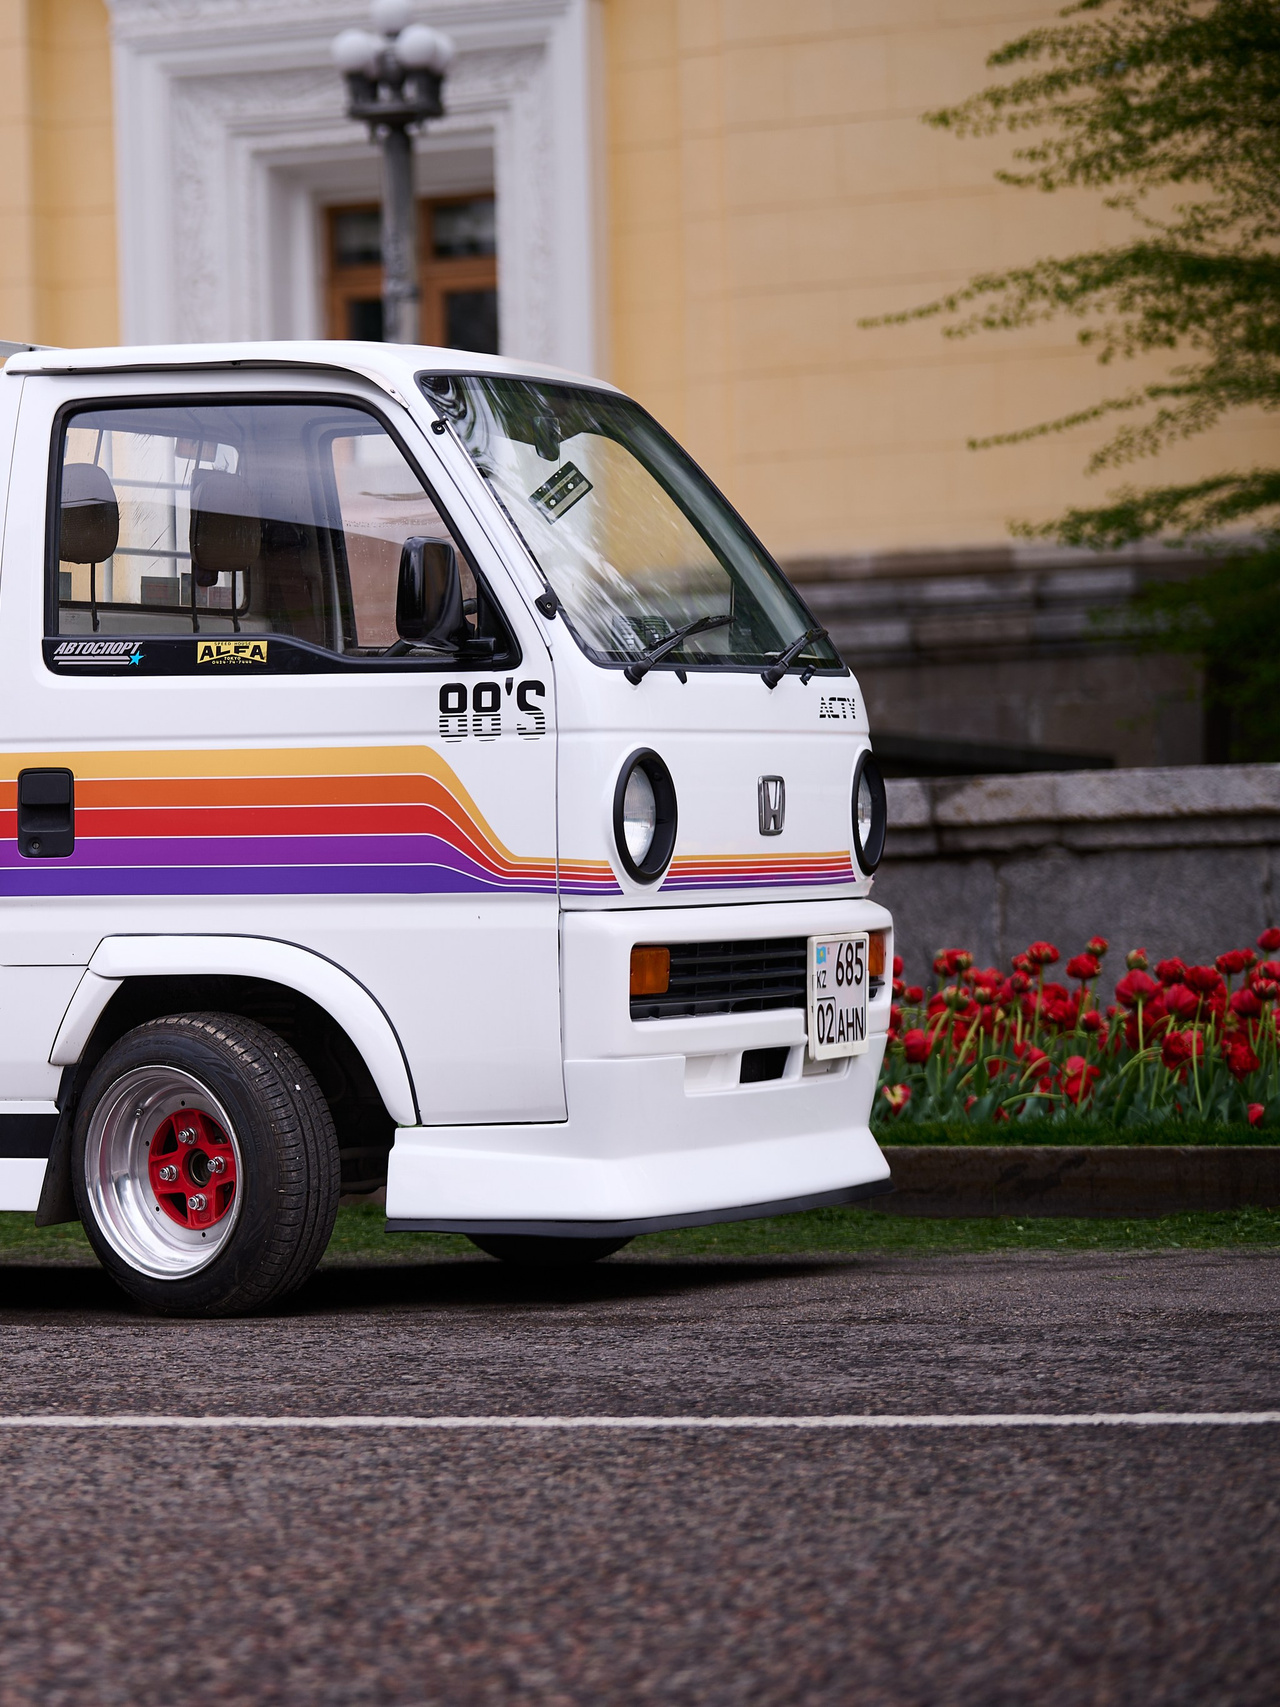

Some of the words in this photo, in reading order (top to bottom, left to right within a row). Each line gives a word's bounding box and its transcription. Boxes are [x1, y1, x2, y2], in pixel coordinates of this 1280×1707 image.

[53, 641, 144, 655] АВТОСПОРТ
[200, 645, 264, 660] ALFA
[438, 677, 546, 743] 88'S
[819, 696, 856, 720] ACTY
[835, 941, 864, 987] 685
[816, 970, 827, 989] KZ
[817, 1002, 835, 1044] 02
[837, 1006, 864, 1042] AHN
